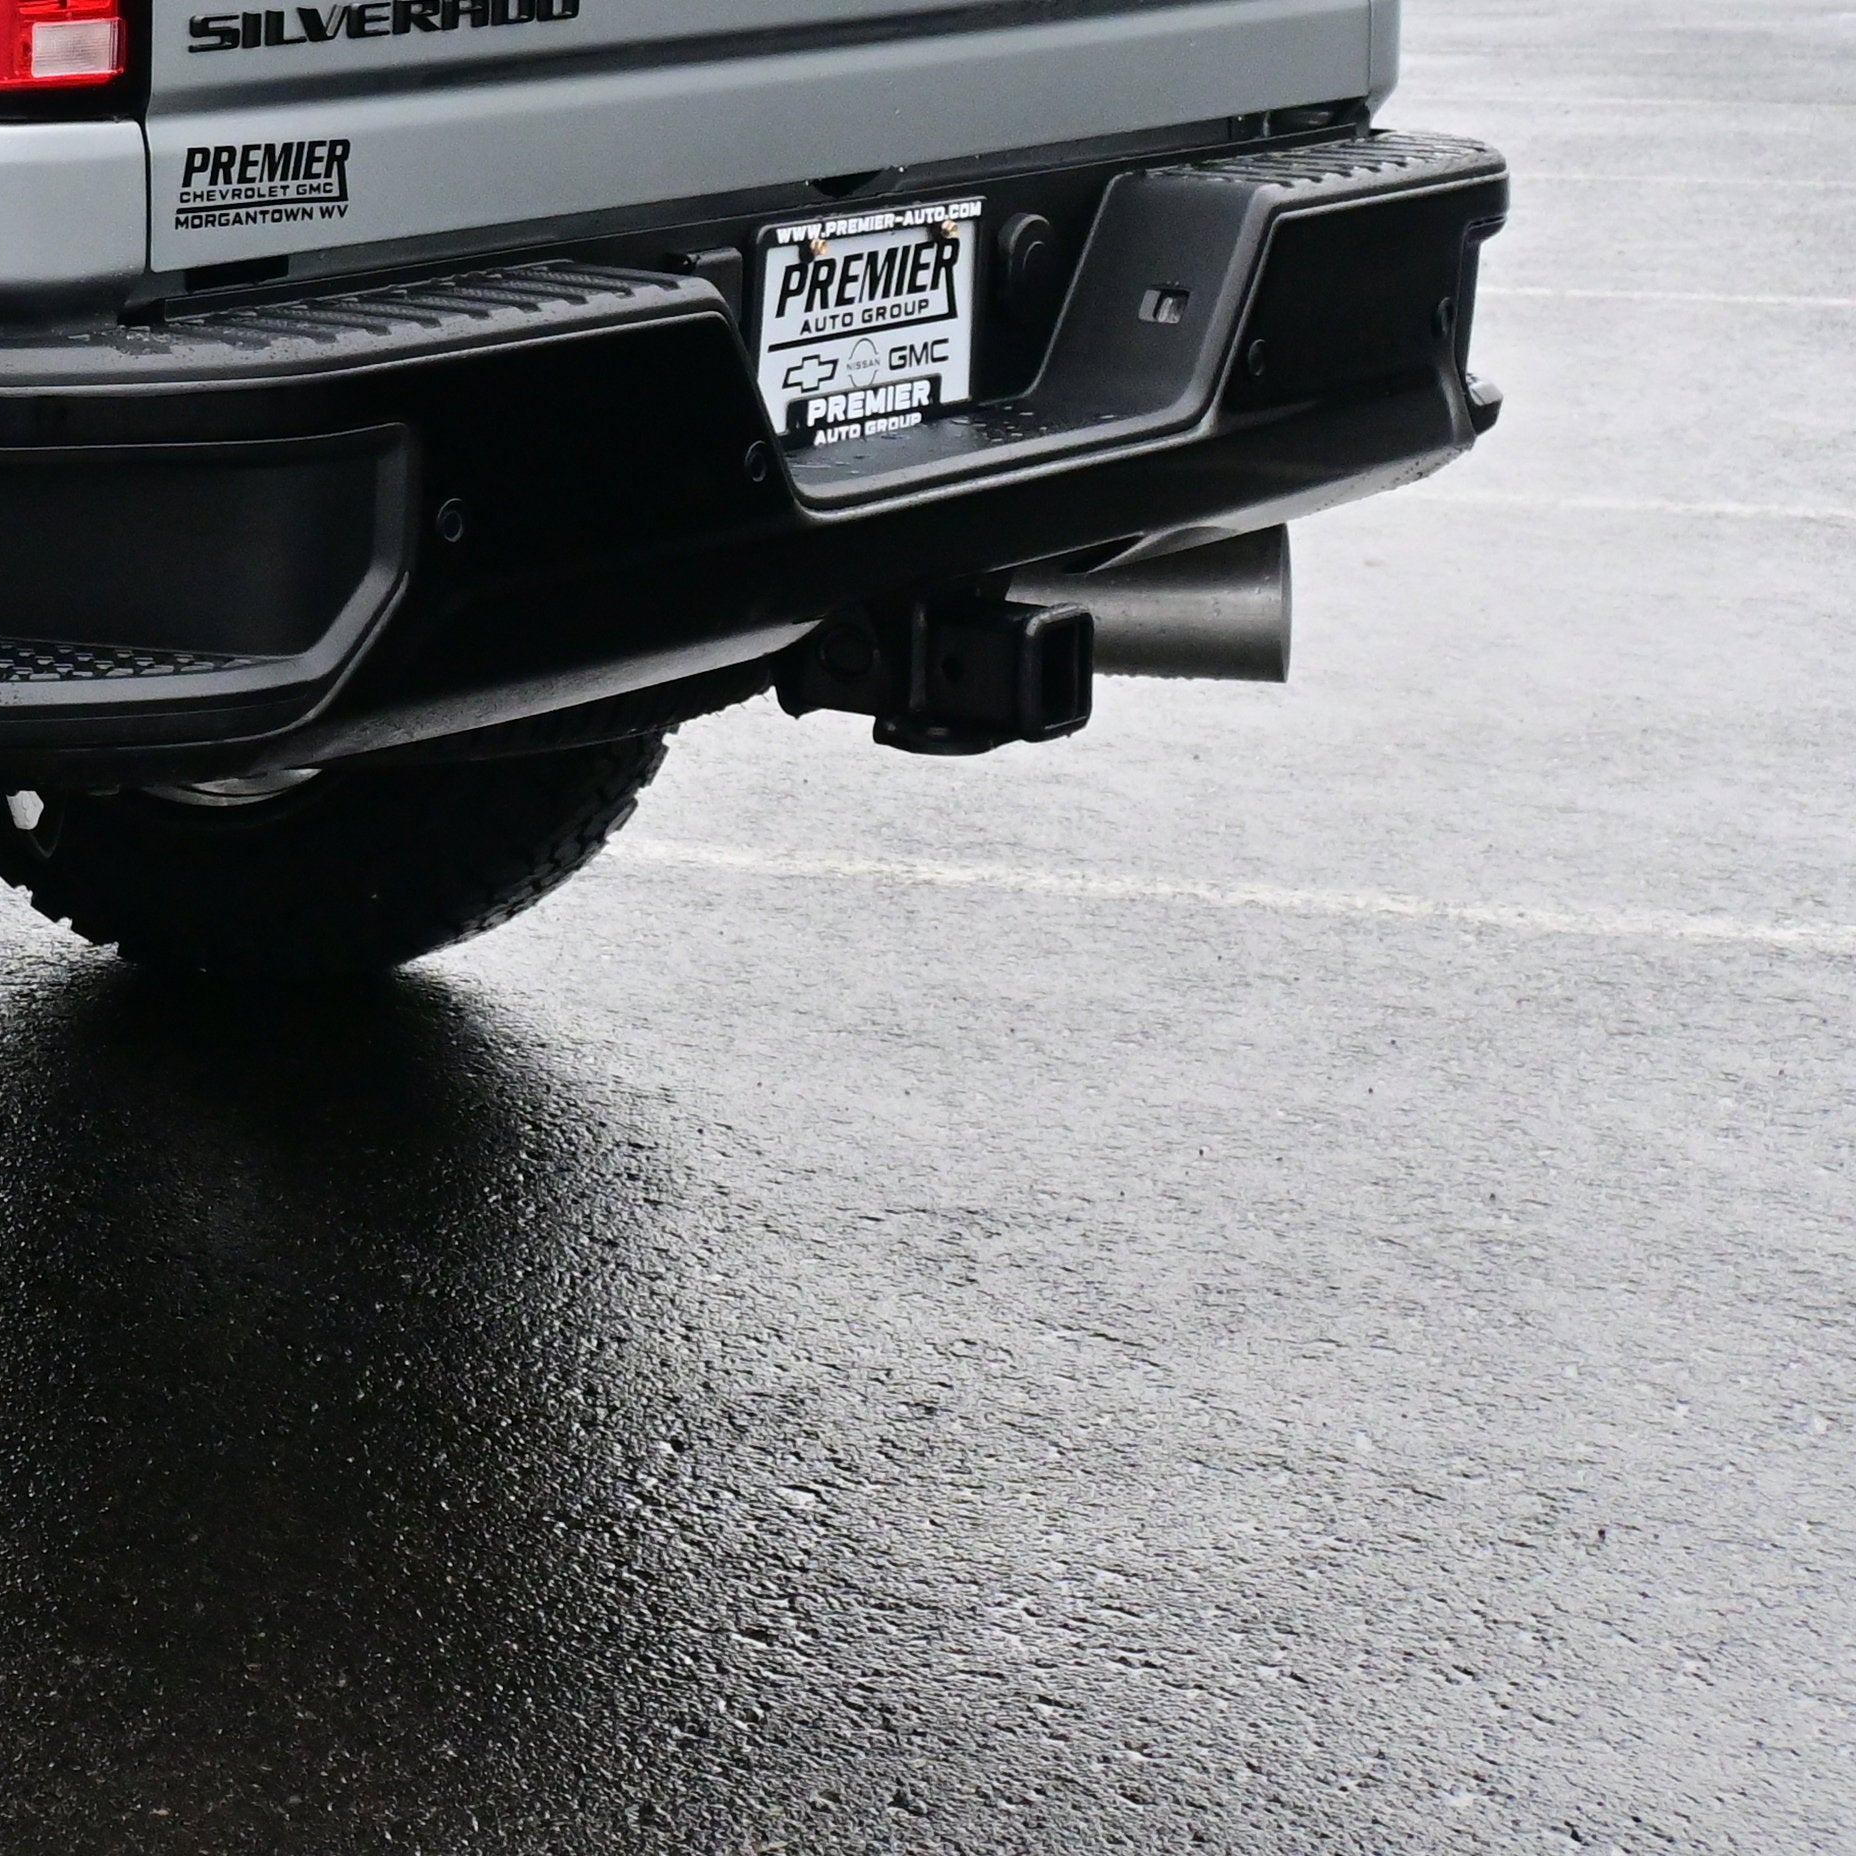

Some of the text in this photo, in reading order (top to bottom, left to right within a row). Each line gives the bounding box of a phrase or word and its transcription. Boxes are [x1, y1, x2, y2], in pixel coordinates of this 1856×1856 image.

[181, 138, 352, 189] PREMIER
[179, 182, 334, 204] CHEVROLET GMC
[174, 204, 349, 231] MORGANTOWN WV
[775, 200, 983, 245] WWW.PREMIER-AUTO.COM
[774, 237, 961, 319] PREMIER
[799, 298, 930, 336] AUTO GROUP
[846, 357, 881, 371] NISSAN
[888, 338, 950, 372] GMC
[805, 378, 931, 428] PREMIER
[813, 411, 923, 447] AUTO GROUP
